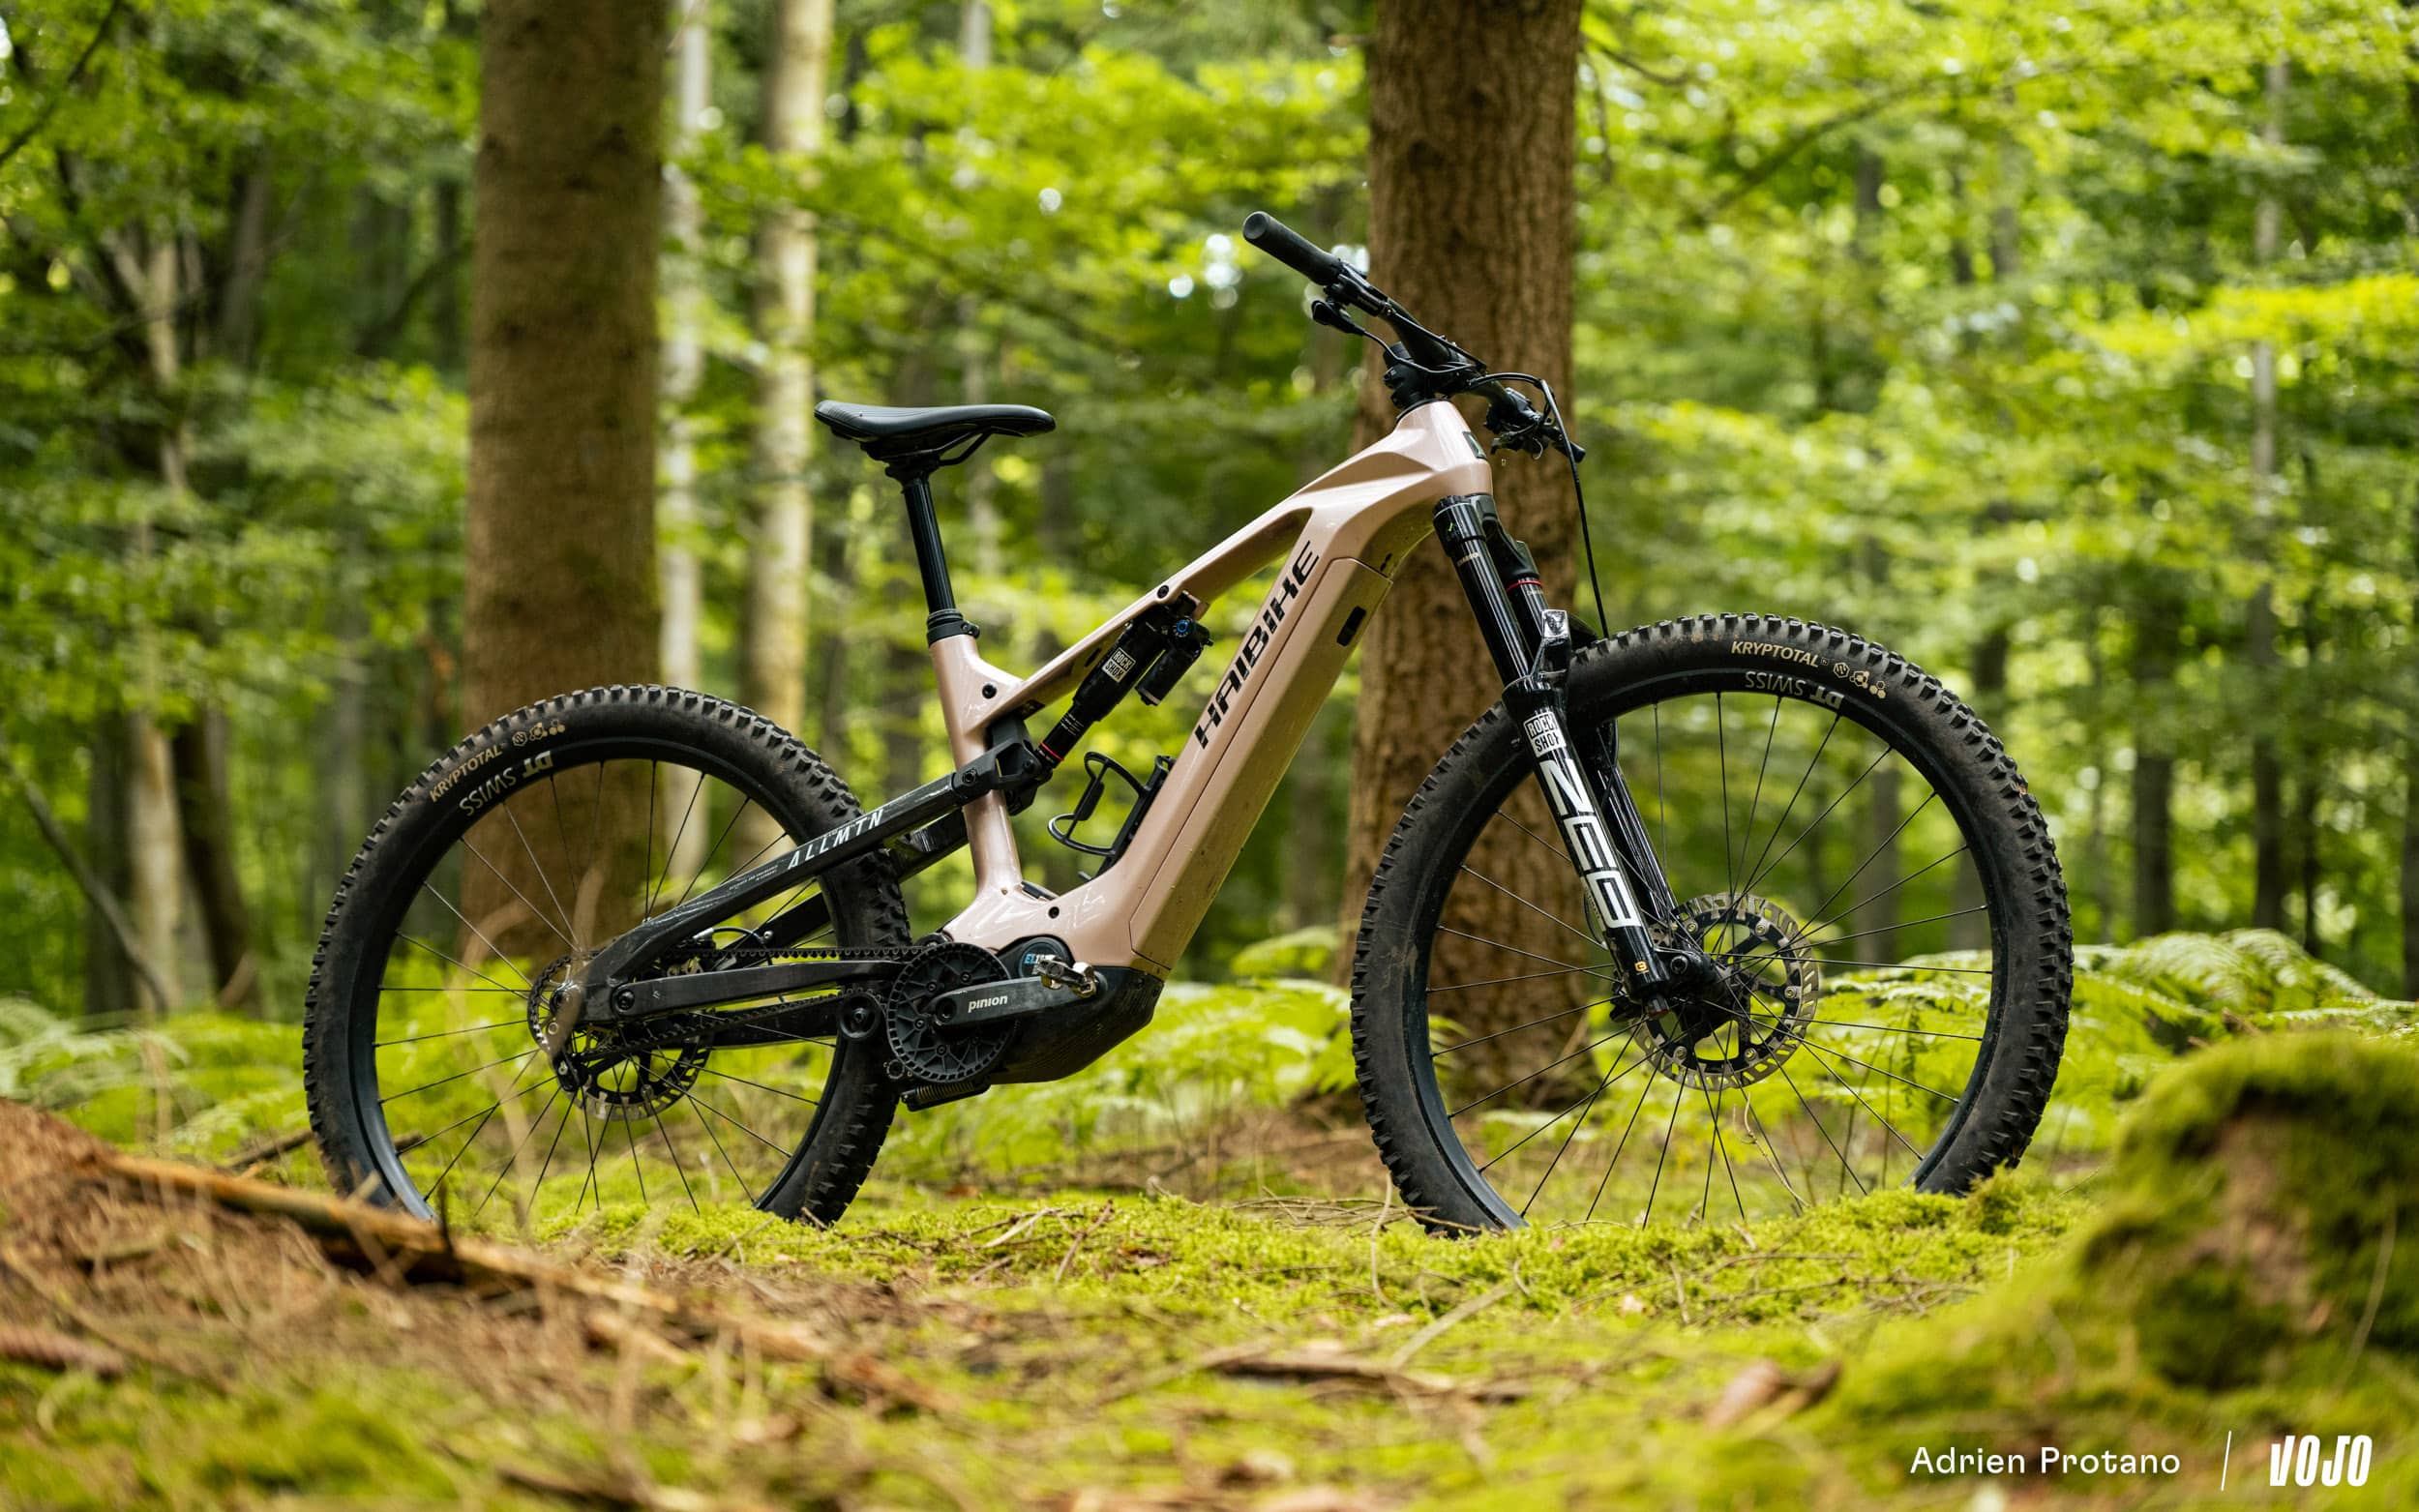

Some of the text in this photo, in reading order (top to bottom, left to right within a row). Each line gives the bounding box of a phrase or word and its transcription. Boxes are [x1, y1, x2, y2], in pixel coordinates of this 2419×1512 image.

[1113, 650, 1133, 670] ROCK
[1194, 540, 1320, 750] HAIBIKE
[1730, 640, 1819, 668] KRYPTOTAL
[1105, 660, 1123, 679] SHOX
[1745, 670, 1845, 709] DT SWISS
[1527, 714, 1557, 737] ROCK
[429, 744, 503, 803] KRYPTOTAL
[459, 750, 553, 816] DT SWISS
[787, 809, 884, 870] ALLMTN
[968, 994, 1008, 1014] pinion
